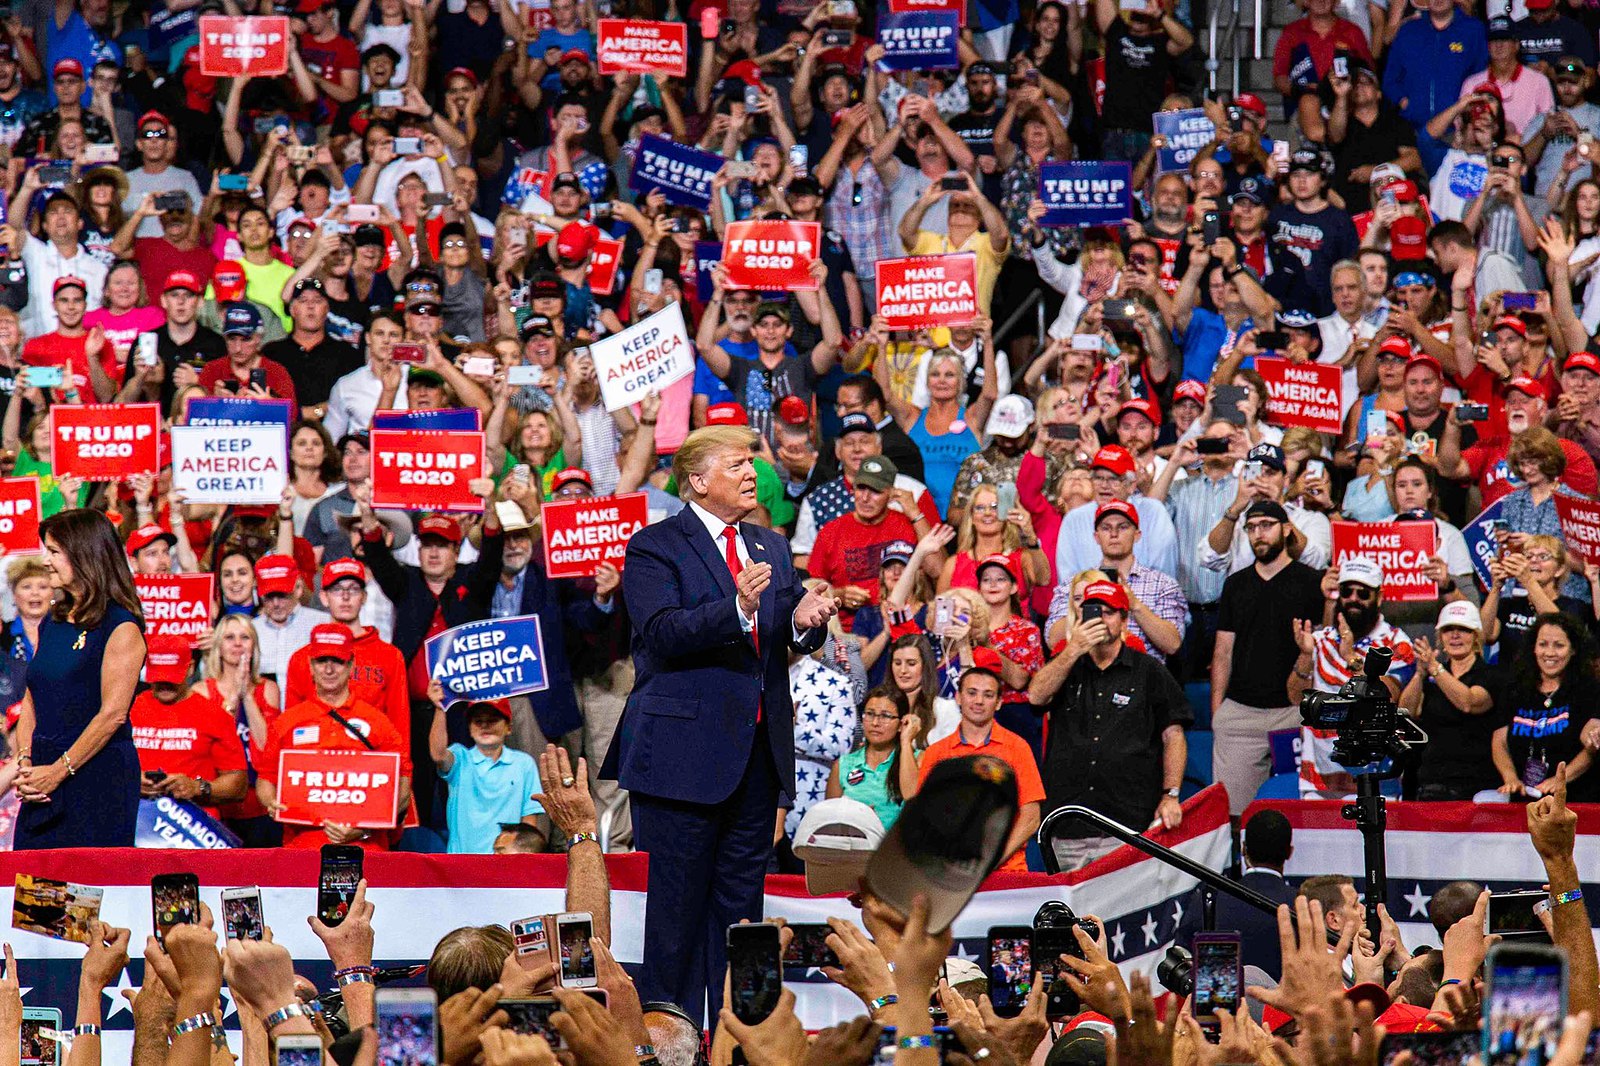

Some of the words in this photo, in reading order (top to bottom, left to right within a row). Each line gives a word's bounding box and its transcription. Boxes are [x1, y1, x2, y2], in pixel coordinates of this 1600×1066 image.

[207, 33, 281, 45] TRUMP
[624, 27, 660, 38] MAKE
[880, 26, 952, 41] TRUMP
[602, 37, 682, 52] AMERICA
[885, 39, 945, 49] PENCE
[644, 53, 682, 64] AGAIN
[643, 149, 717, 183] TRUMP
[645, 164, 707, 192] PENCE
[1044, 179, 1125, 194] TRUMP
[1051, 193, 1117, 203] PENCE
[730, 239, 812, 254] TRUMP
[744, 255, 794, 269] 2020
[904, 267, 945, 281] MAKE
[881, 280, 973, 302] AMERICA
[881, 302, 925, 318] GREAT
[929, 299, 974, 315] AGAIN
[622, 327, 660, 356] KEEP
[606, 333, 682, 383] AMERICA
[624, 356, 677, 393] GREAT!
[1284, 368, 1319, 384] MAKE
[1302, 404, 1339, 421] AGAIN
[58, 425, 152, 441] TRUMP
[78, 444, 132, 458] 2020
[204, 438, 252, 453] KEEP
[181, 457, 278, 473] AMERICA
[379, 451, 476, 469] TRUMP
[196, 478, 264, 491] GREAT!
[399, 470, 455, 486] 2020
[576, 507, 619, 524] MAKE
[1571, 508, 1600, 524] MAKE
[550, 520, 643, 549] AMERICA
[1358, 534, 1401, 548] MAKE
[551, 547, 602, 564] GREAT
[136, 586, 181, 600] MAKE
[141, 600, 208, 620] ERICA
[1509, 613, 1537, 626] TRU
[158, 621, 208, 635] AGAIN
[453, 629, 506, 653] KEEP
[432, 644, 537, 680] AMERICA
[449, 666, 523, 693] GREAT!
[287, 770, 389, 788] TRUMP
[307, 789, 367, 804] 2020
